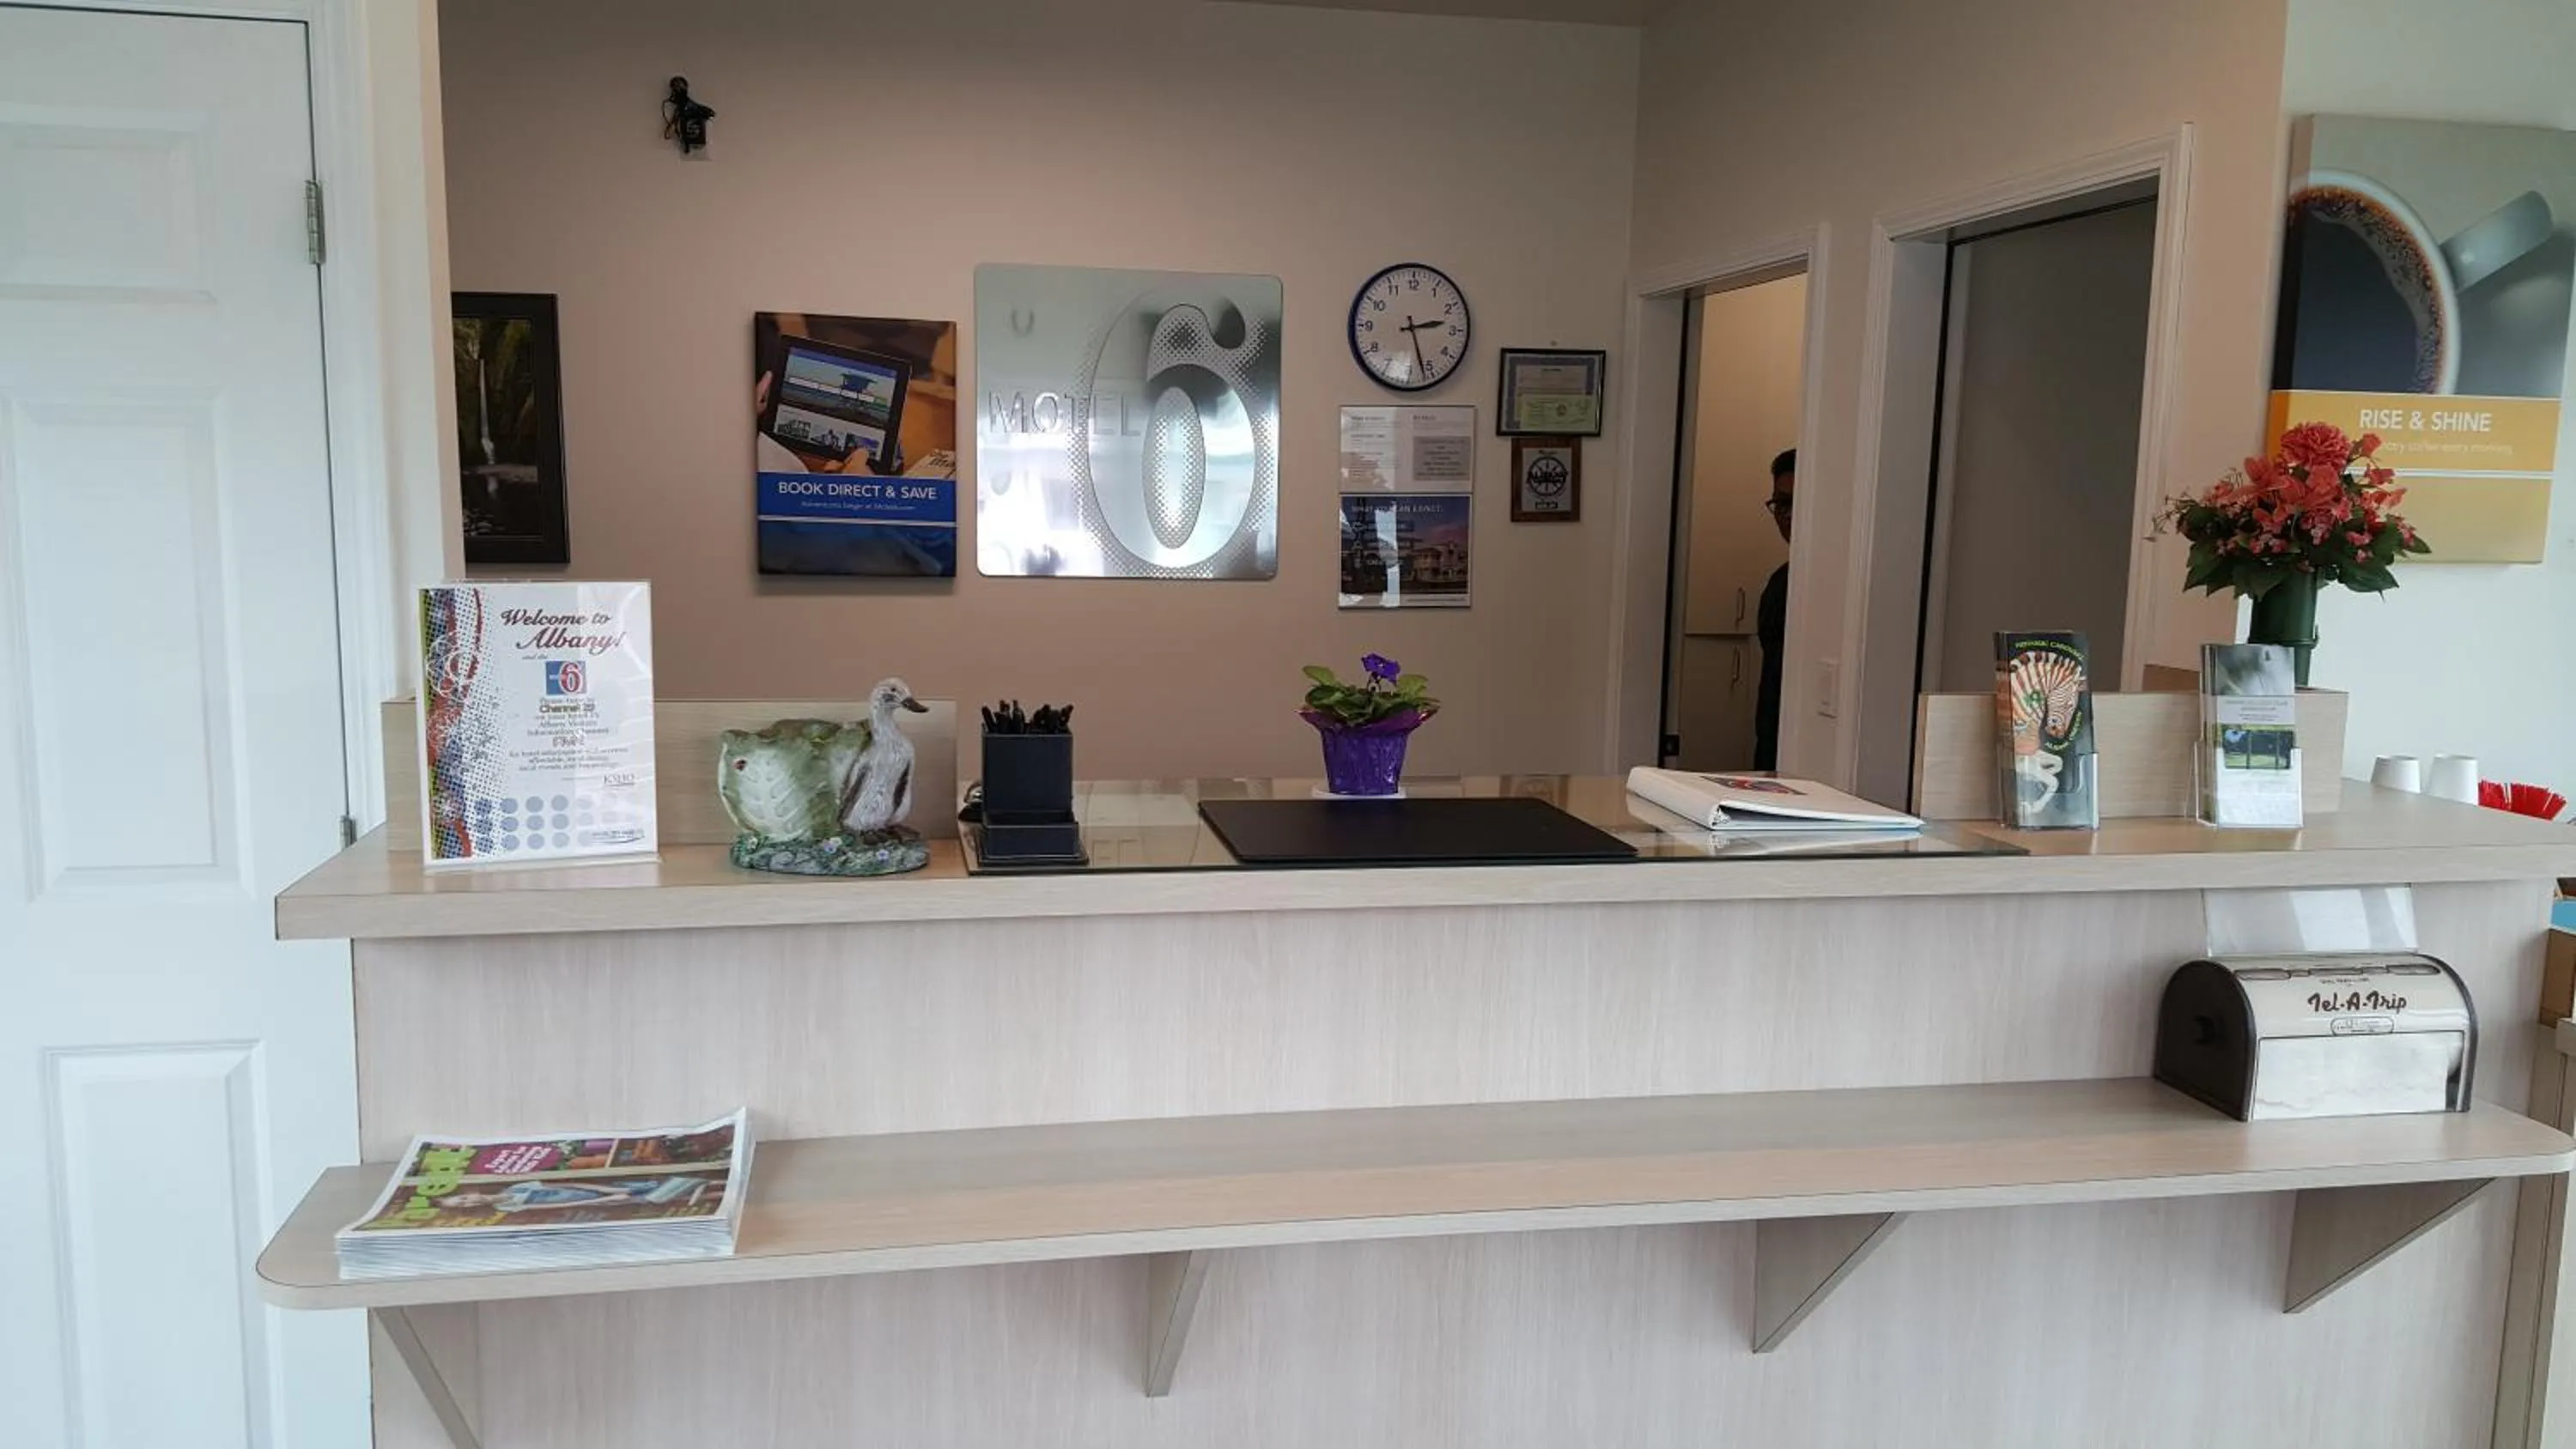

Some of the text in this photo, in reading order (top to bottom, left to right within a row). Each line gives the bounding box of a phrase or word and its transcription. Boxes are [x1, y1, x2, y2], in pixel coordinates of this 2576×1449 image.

[1388, 285, 1399, 295] 11
[1408, 279, 1419, 290] 12
[1431, 288, 1437, 298] 1
[1374, 300, 1385, 311] 10
[1444, 304, 1452, 315] 2
[1364, 320, 1373, 331] 9
[1449, 325, 1456, 336] 3
[1370, 343, 1378, 353] 8
[1441, 346, 1449, 356] 4
[1425, 361, 1433, 371] 5
[2359, 409, 2493, 432] RISE & SHINE
[987, 288, 1256, 568] MOTEL 6
[778, 482, 938, 500] BOOK DIRECT & SAVE
[501, 608, 613, 626] Welcome to
[515, 626, 627, 656] Albany!
[560, 662, 581, 693] 6
[539, 703, 581, 713] Channel
